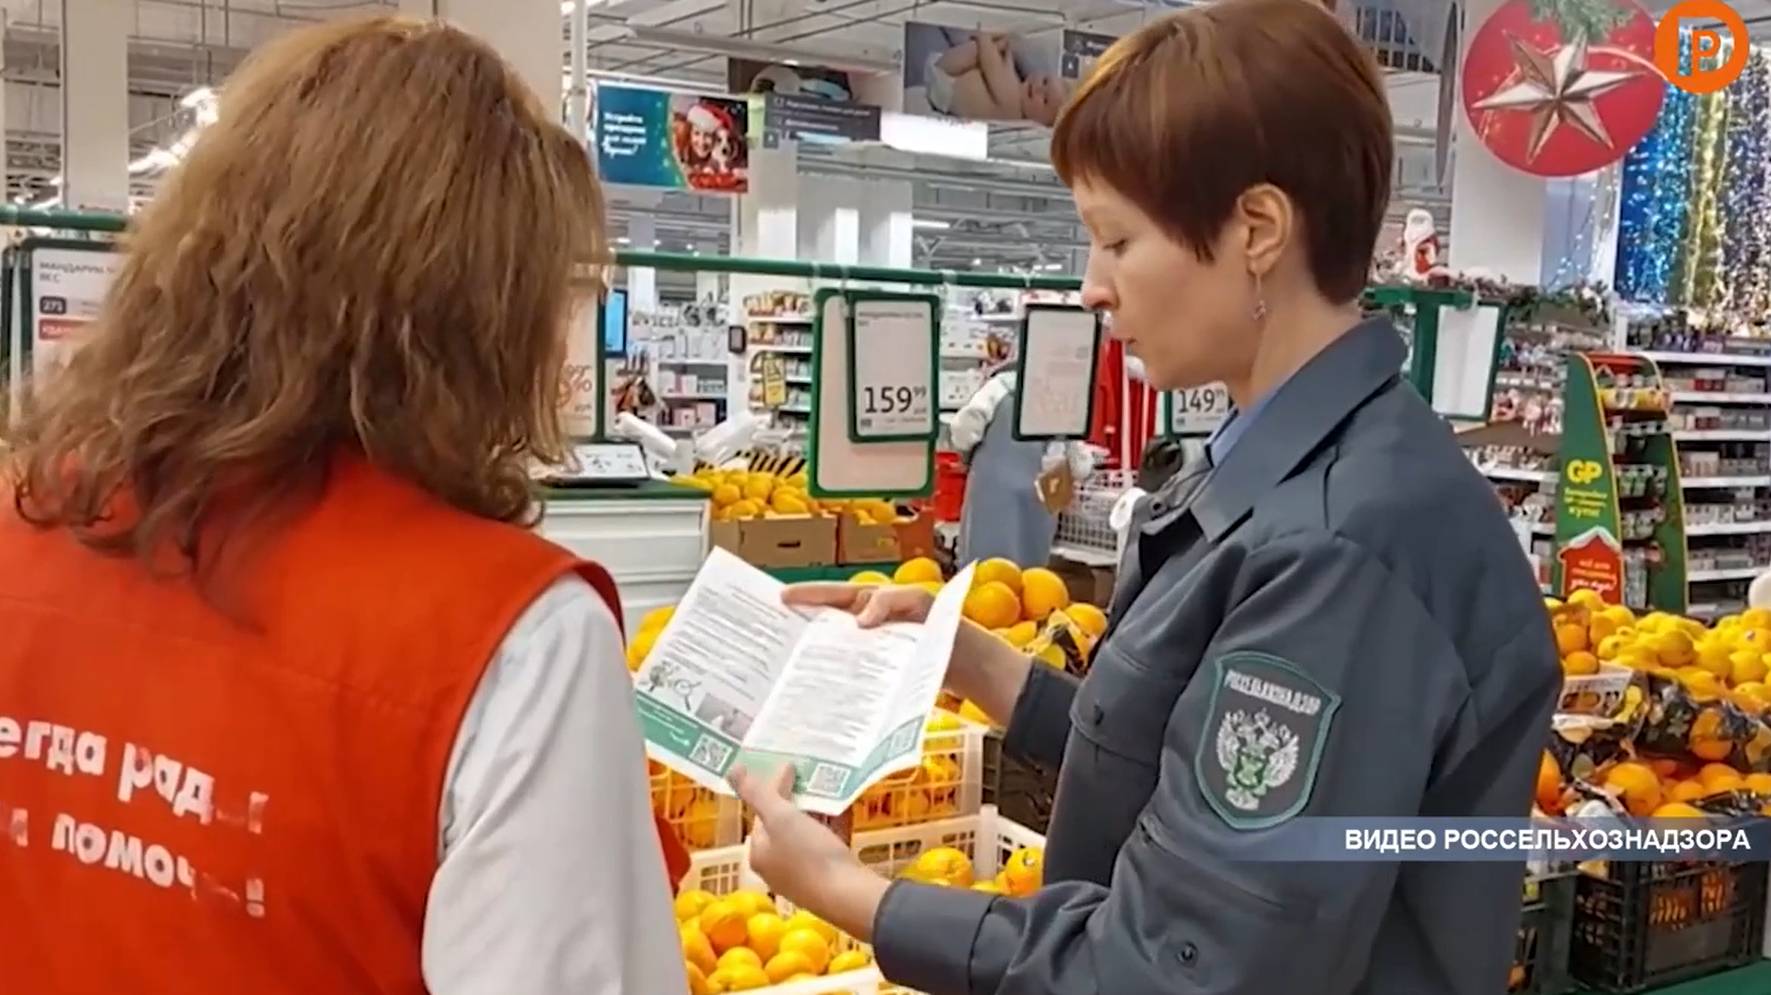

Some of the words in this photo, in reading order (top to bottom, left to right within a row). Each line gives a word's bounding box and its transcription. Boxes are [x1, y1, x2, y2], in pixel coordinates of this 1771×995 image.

[864, 386, 912, 413] 159
[1178, 388, 1215, 413] 149
[1567, 459, 1603, 484] GP
